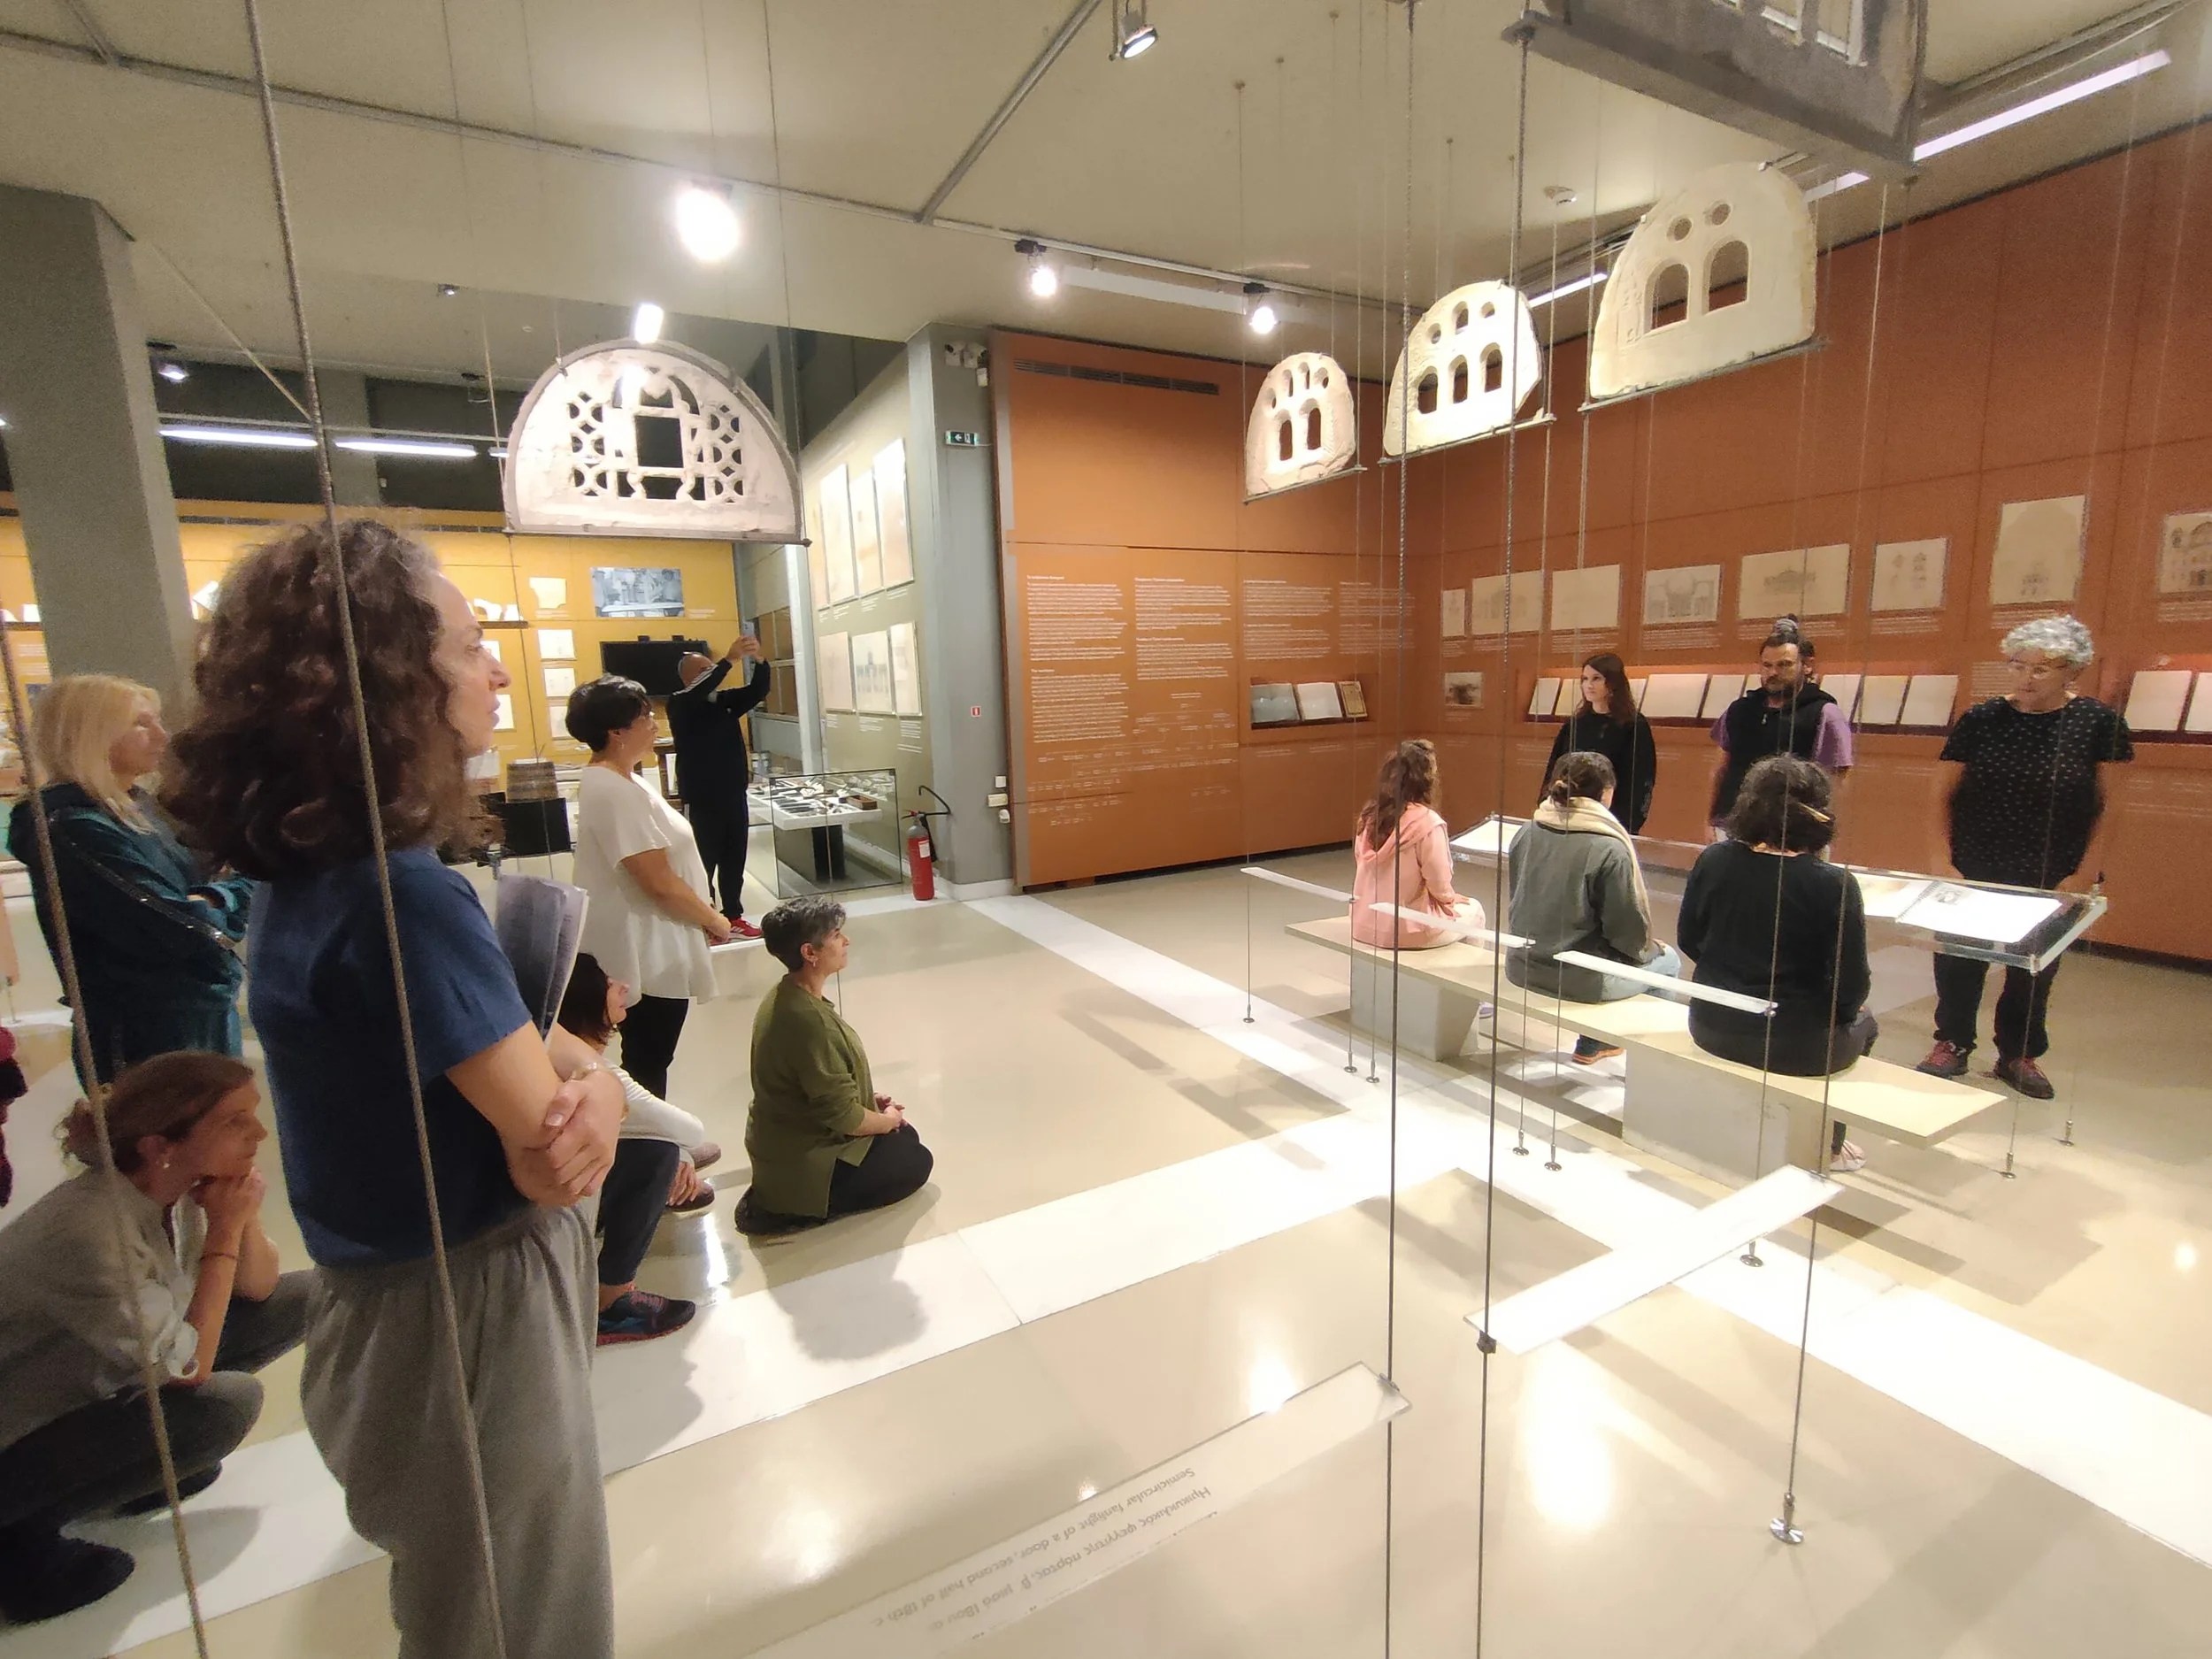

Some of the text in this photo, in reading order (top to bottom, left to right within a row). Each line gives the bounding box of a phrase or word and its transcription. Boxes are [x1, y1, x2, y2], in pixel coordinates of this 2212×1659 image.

[1126, 1467, 1195, 1507] Semicircular
[1079, 1503, 1125, 1530] fanlight
[1138, 1486, 1211, 1527] Ημικυκλικός
[1051, 1532, 1061, 1541] a
[1064, 1525, 1076, 1540] of
[1013, 1539, 1050, 1558] door,
[966, 1555, 1014, 1586] second
[939, 1579, 965, 1600] half
[887, 1601, 918, 1622] 18th
[921, 1593, 935, 1609] of
